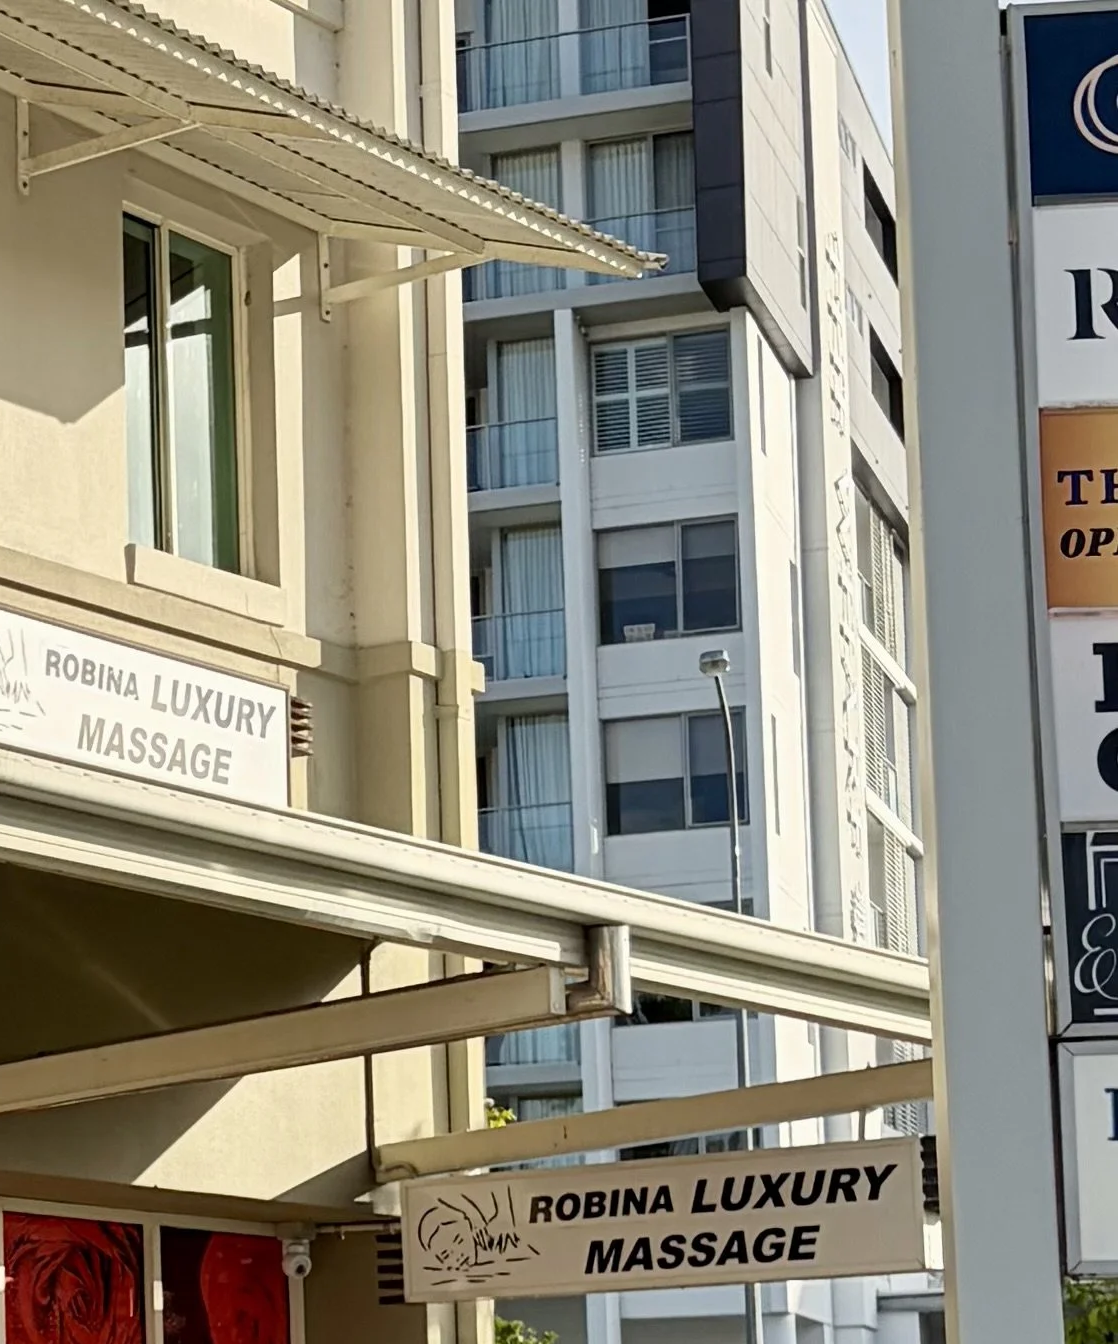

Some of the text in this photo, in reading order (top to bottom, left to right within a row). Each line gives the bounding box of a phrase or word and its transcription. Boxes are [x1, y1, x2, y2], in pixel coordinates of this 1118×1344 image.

[1060, 527, 1118, 558] OP
[45, 649, 277, 740] ROBINA LUXURY
[77, 714, 233, 785] MASSAGE
[529, 1163, 898, 1224] ROBINA LUXURY
[584, 1225, 821, 1275] MASSAGE
